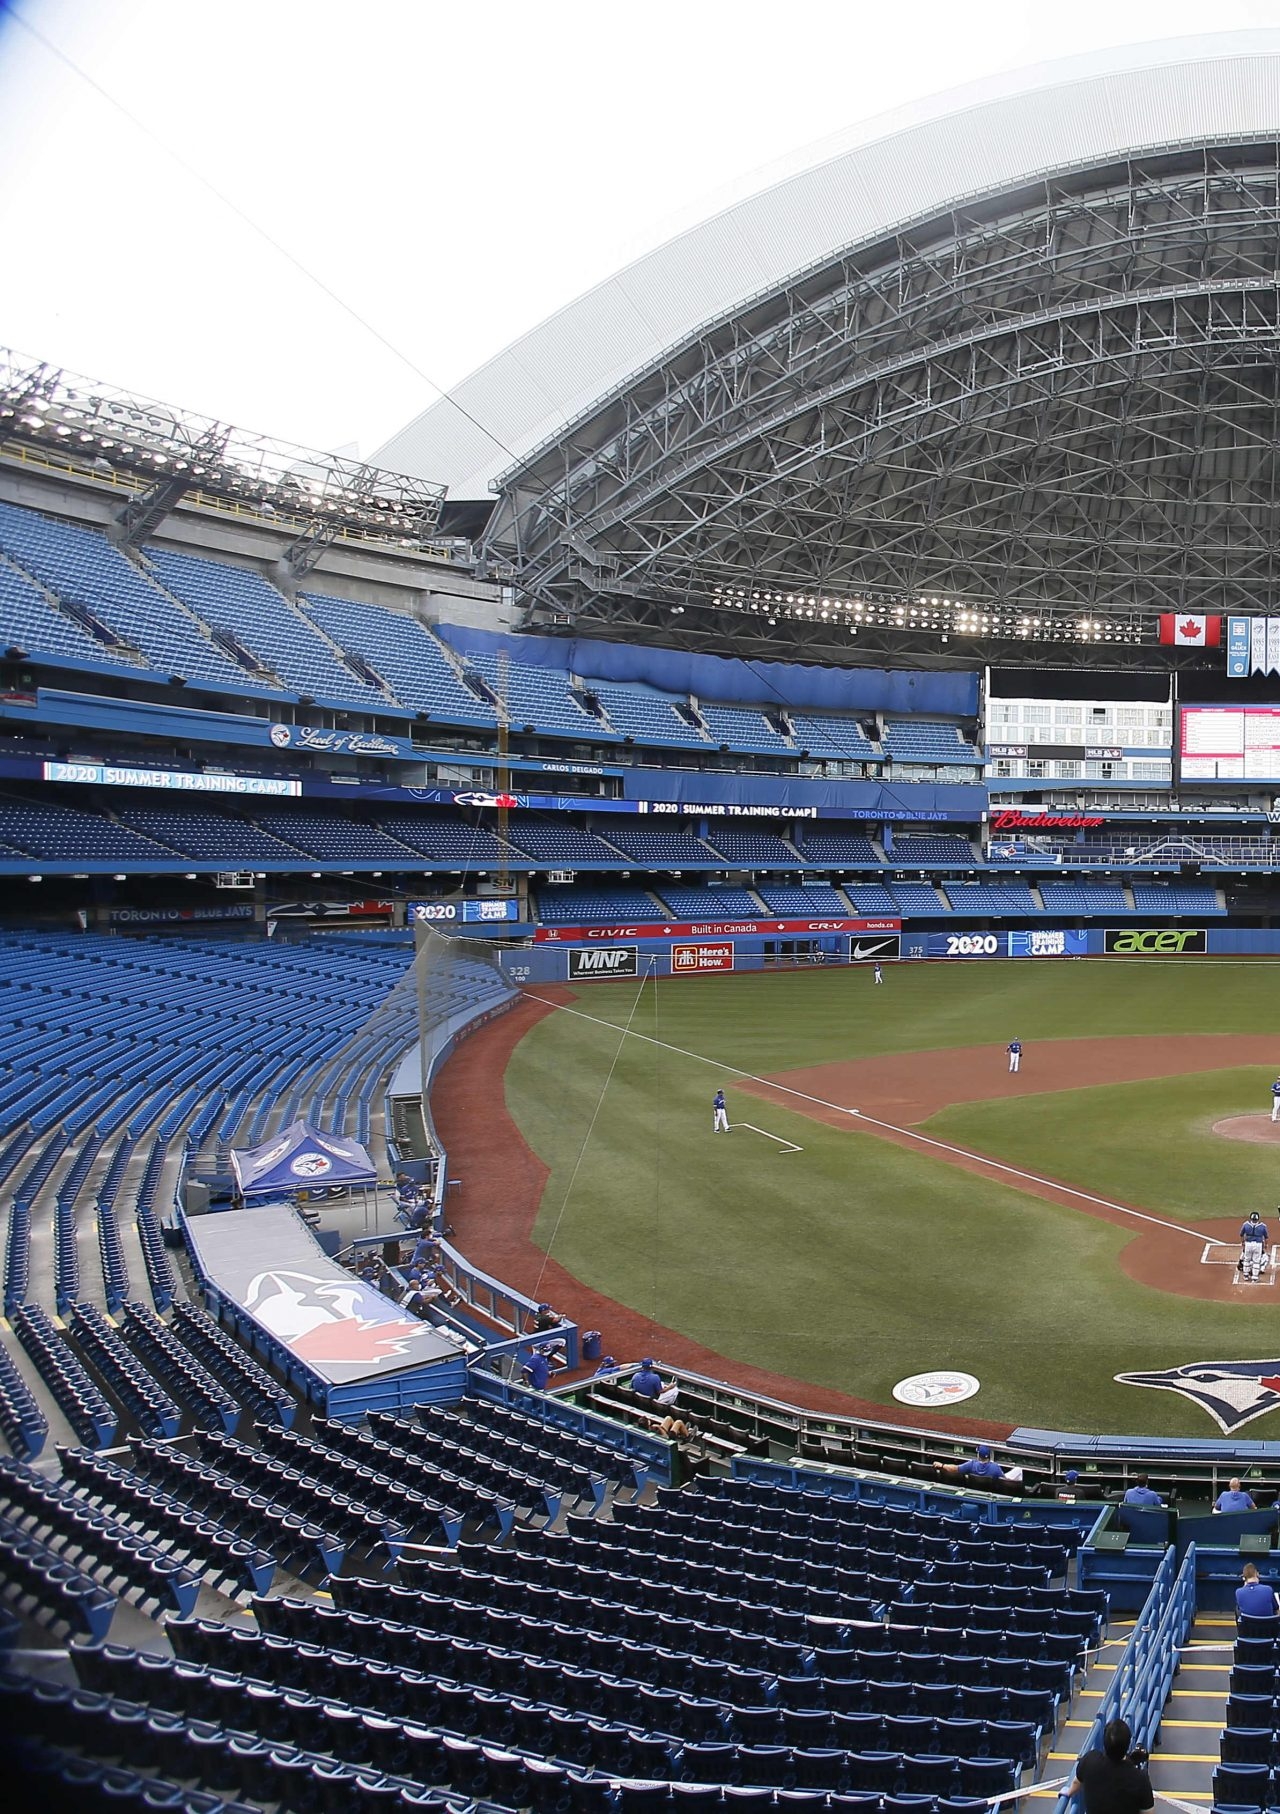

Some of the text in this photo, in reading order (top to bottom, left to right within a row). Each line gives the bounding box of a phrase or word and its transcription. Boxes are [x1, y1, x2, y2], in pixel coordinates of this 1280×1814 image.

[296, 726, 400, 755] Level of Excellence
[542, 764, 604, 774] CARLOS DELGADO
[57, 764, 287, 794] 2020 SUMMER TRAINING CAMP
[652, 803, 811, 818] 2020 SUMMER TRAINING CAMP
[852, 810, 948, 820] TORONTO BLUE JAYS
[991, 810, 1104, 828] Budweiser
[112, 906, 252, 920] TORONTO BLUE JAYS
[416, 905, 456, 919] 2020
[481, 911, 508, 919] CAMP
[691, 925, 712, 934] Built
[724, 924, 757, 933] Canada
[808, 922, 844, 930] CR-V
[588, 928, 638, 938] CIVIC
[946, 935, 998, 955] 2020
[1113, 930, 1199, 952] acer
[699, 948, 730, 956] Here's
[1032, 944, 1065, 955] CAMP
[578, 950, 628, 969] MNP
[699, 958, 724, 967] How.
[509, 966, 530, 976] 328
